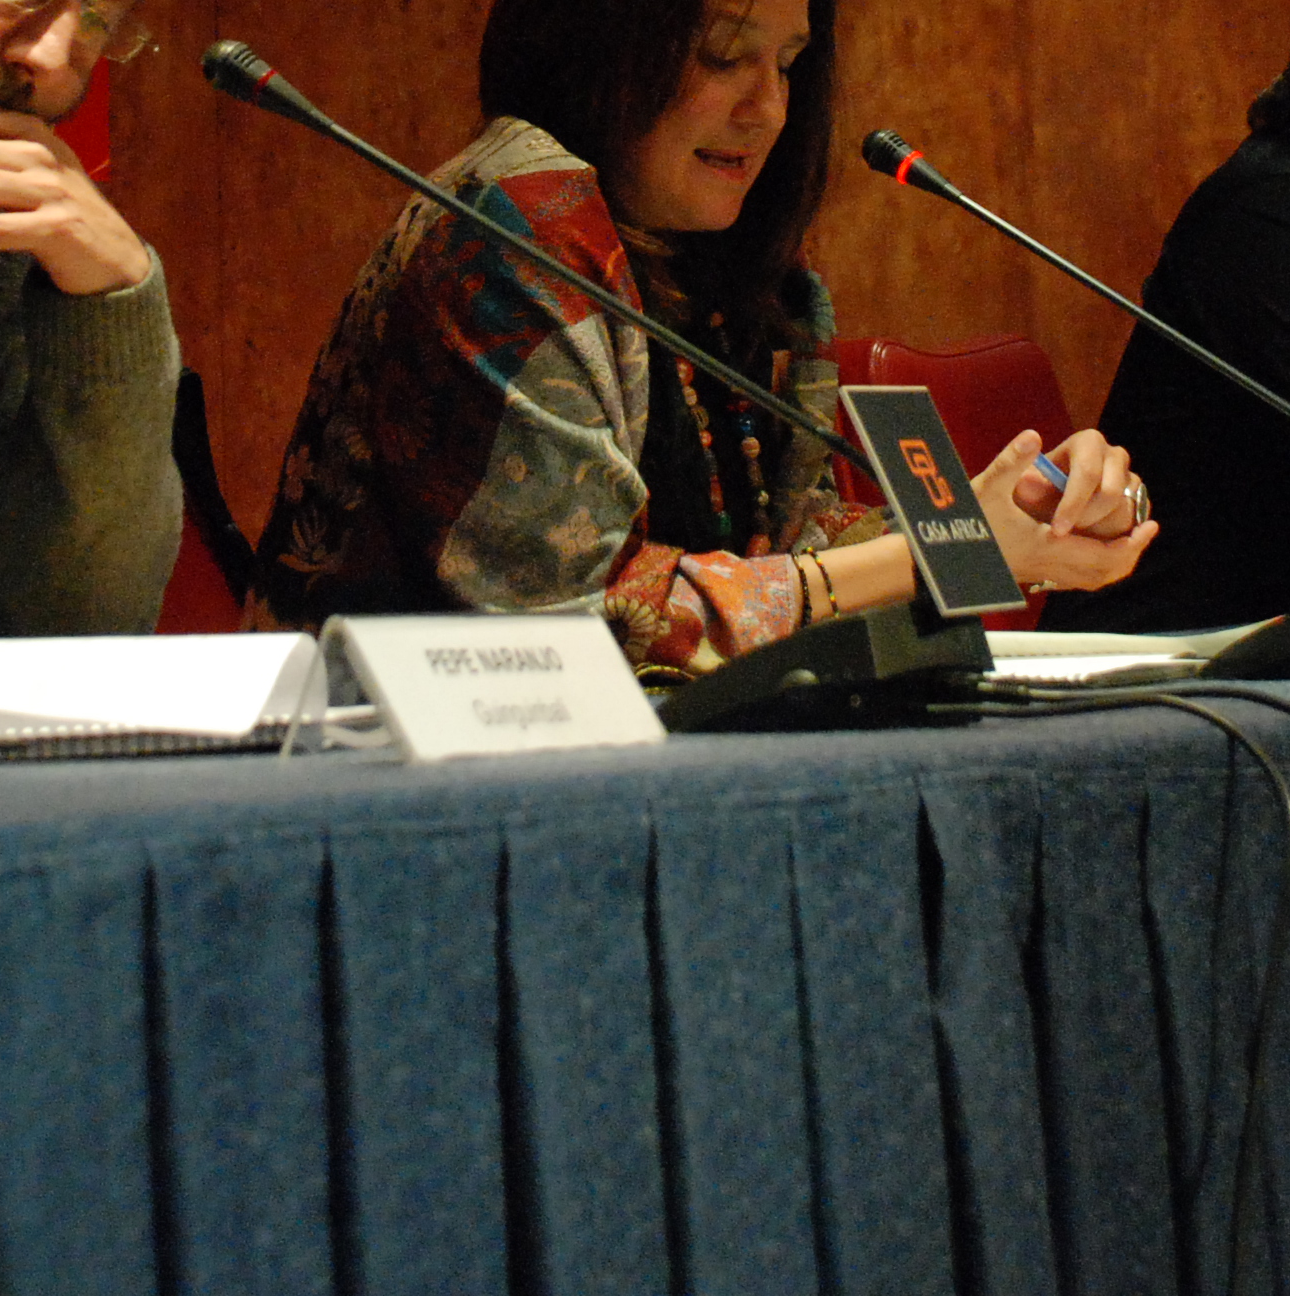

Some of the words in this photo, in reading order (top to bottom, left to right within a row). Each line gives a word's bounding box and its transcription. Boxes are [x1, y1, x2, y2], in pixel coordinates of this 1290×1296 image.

[917, 519, 950, 543] CASA
[950, 517, 989, 540] AFRICA
[424, 647, 479, 674] PEPE
[475, 646, 564, 672] NARANJO
